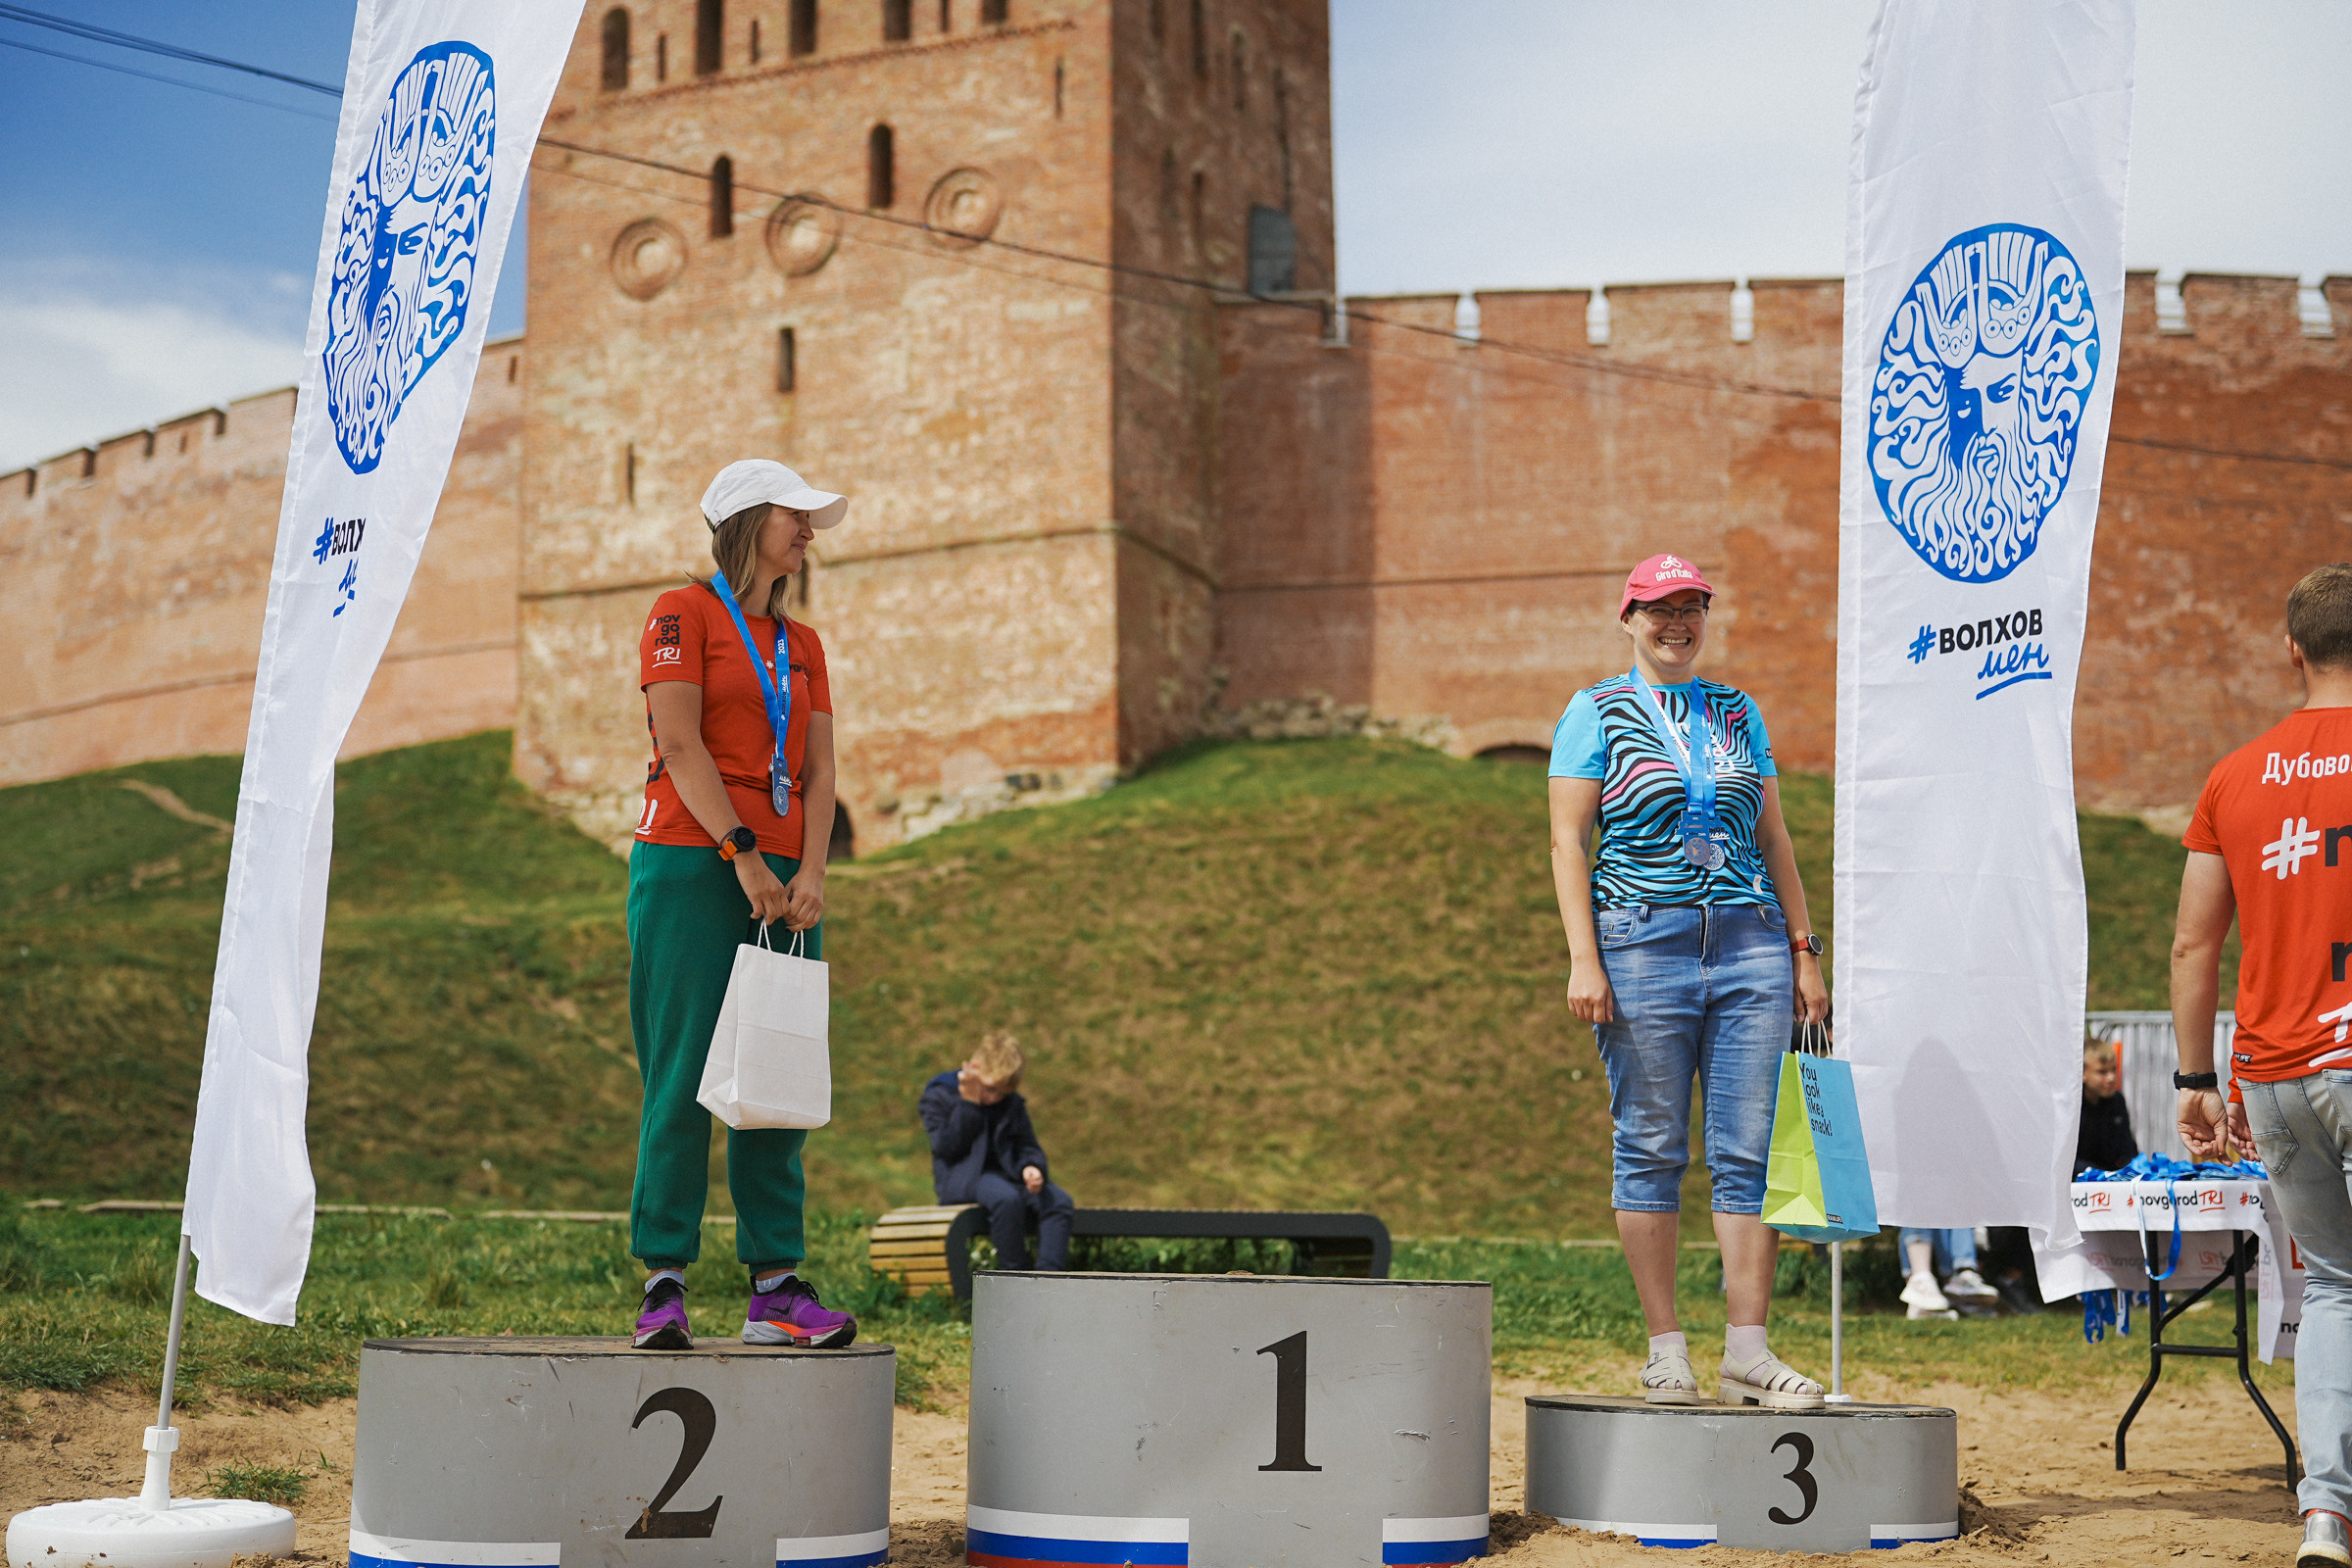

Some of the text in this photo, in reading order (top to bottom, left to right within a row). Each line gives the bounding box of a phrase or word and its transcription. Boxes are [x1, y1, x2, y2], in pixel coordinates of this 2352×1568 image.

[655, 632, 680, 647] rod
[661, 623, 680, 636] go
[1907, 609, 2042, 663] #ВОЛХОВ
[653, 647, 681, 662] TRI
[777, 638, 786, 655] 2023
[1977, 642, 2049, 680] мен
[2261, 751, 2352, 786] Дубово
[1799, 1062, 1817, 1082] You
[1811, 1118, 1833, 1137] snack!
[2071, 1193, 2088, 1206] od
[2089, 1192, 2111, 1206] TRI
[2198, 1190, 2223, 1206] TRI
[1255, 1330, 1323, 1472] 1
[625, 1388, 722, 1539] 2
[1769, 1432, 1818, 1526] 3
